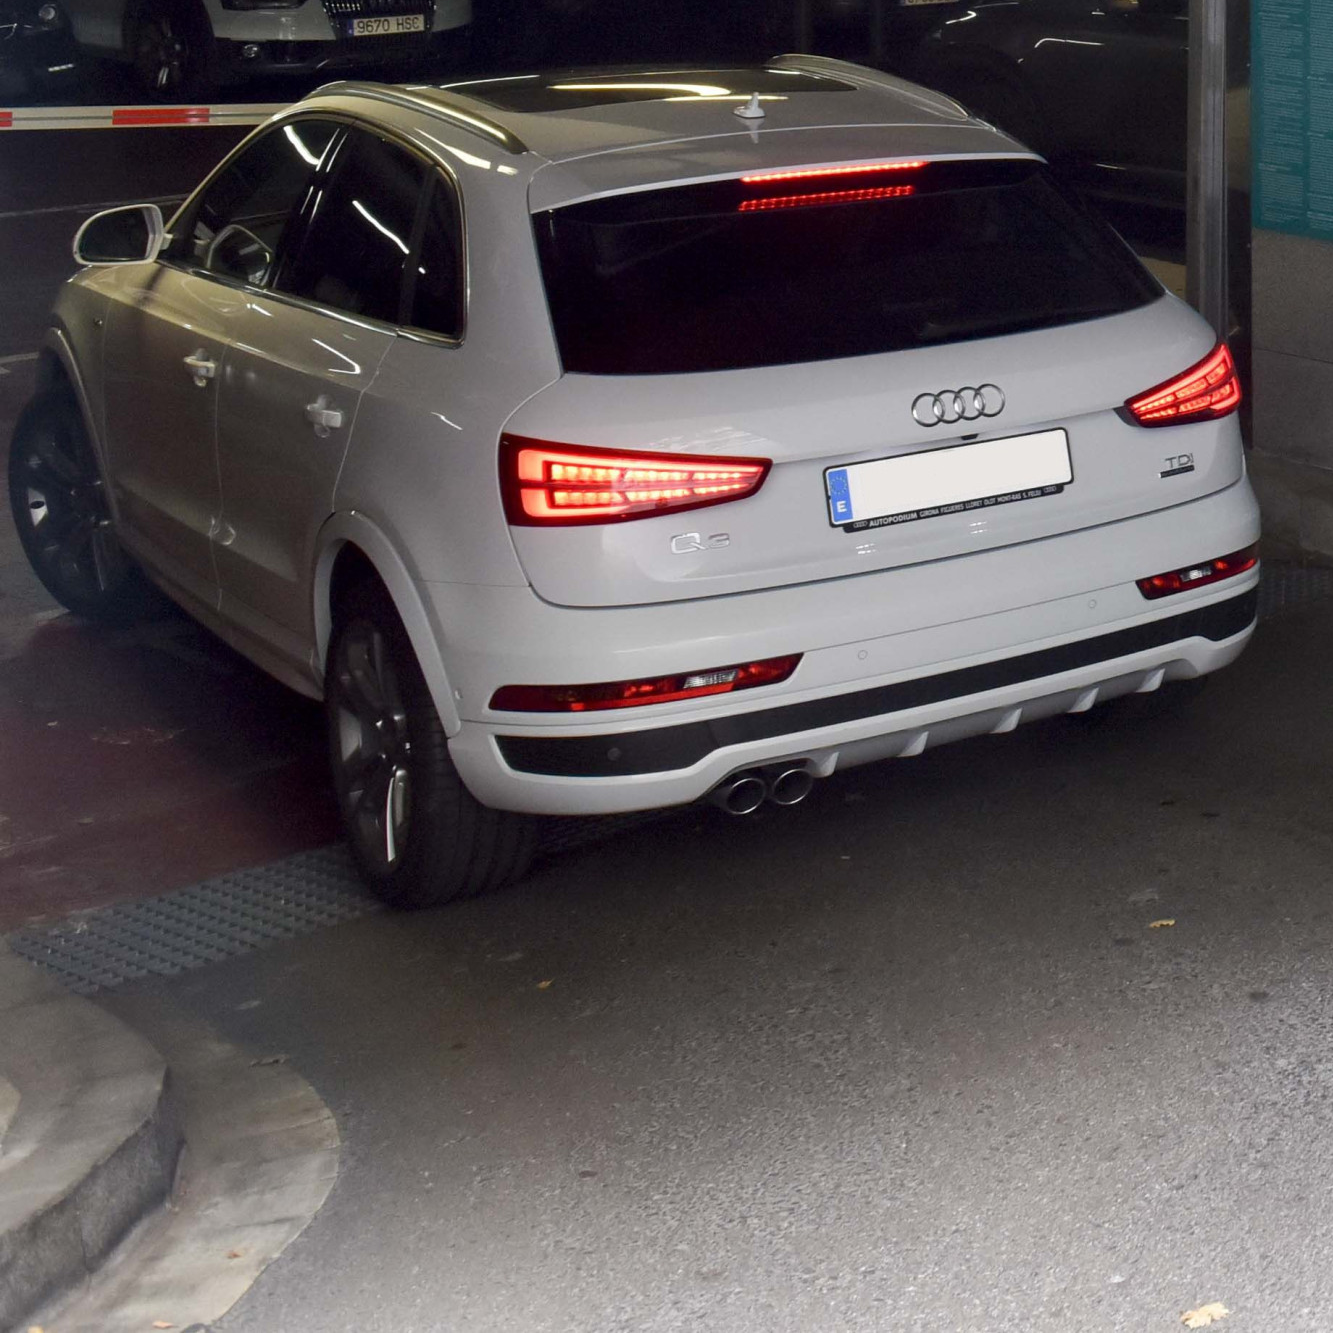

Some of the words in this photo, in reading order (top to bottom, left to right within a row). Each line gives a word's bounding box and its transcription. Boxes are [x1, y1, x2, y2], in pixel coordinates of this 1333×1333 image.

[357, 19, 391, 34] 9670
[1165, 453, 1194, 468] TDI
[837, 500, 847, 513] E
[869, 512, 918, 527] AUTOPODIUM
[671, 532, 730, 554] Q3
